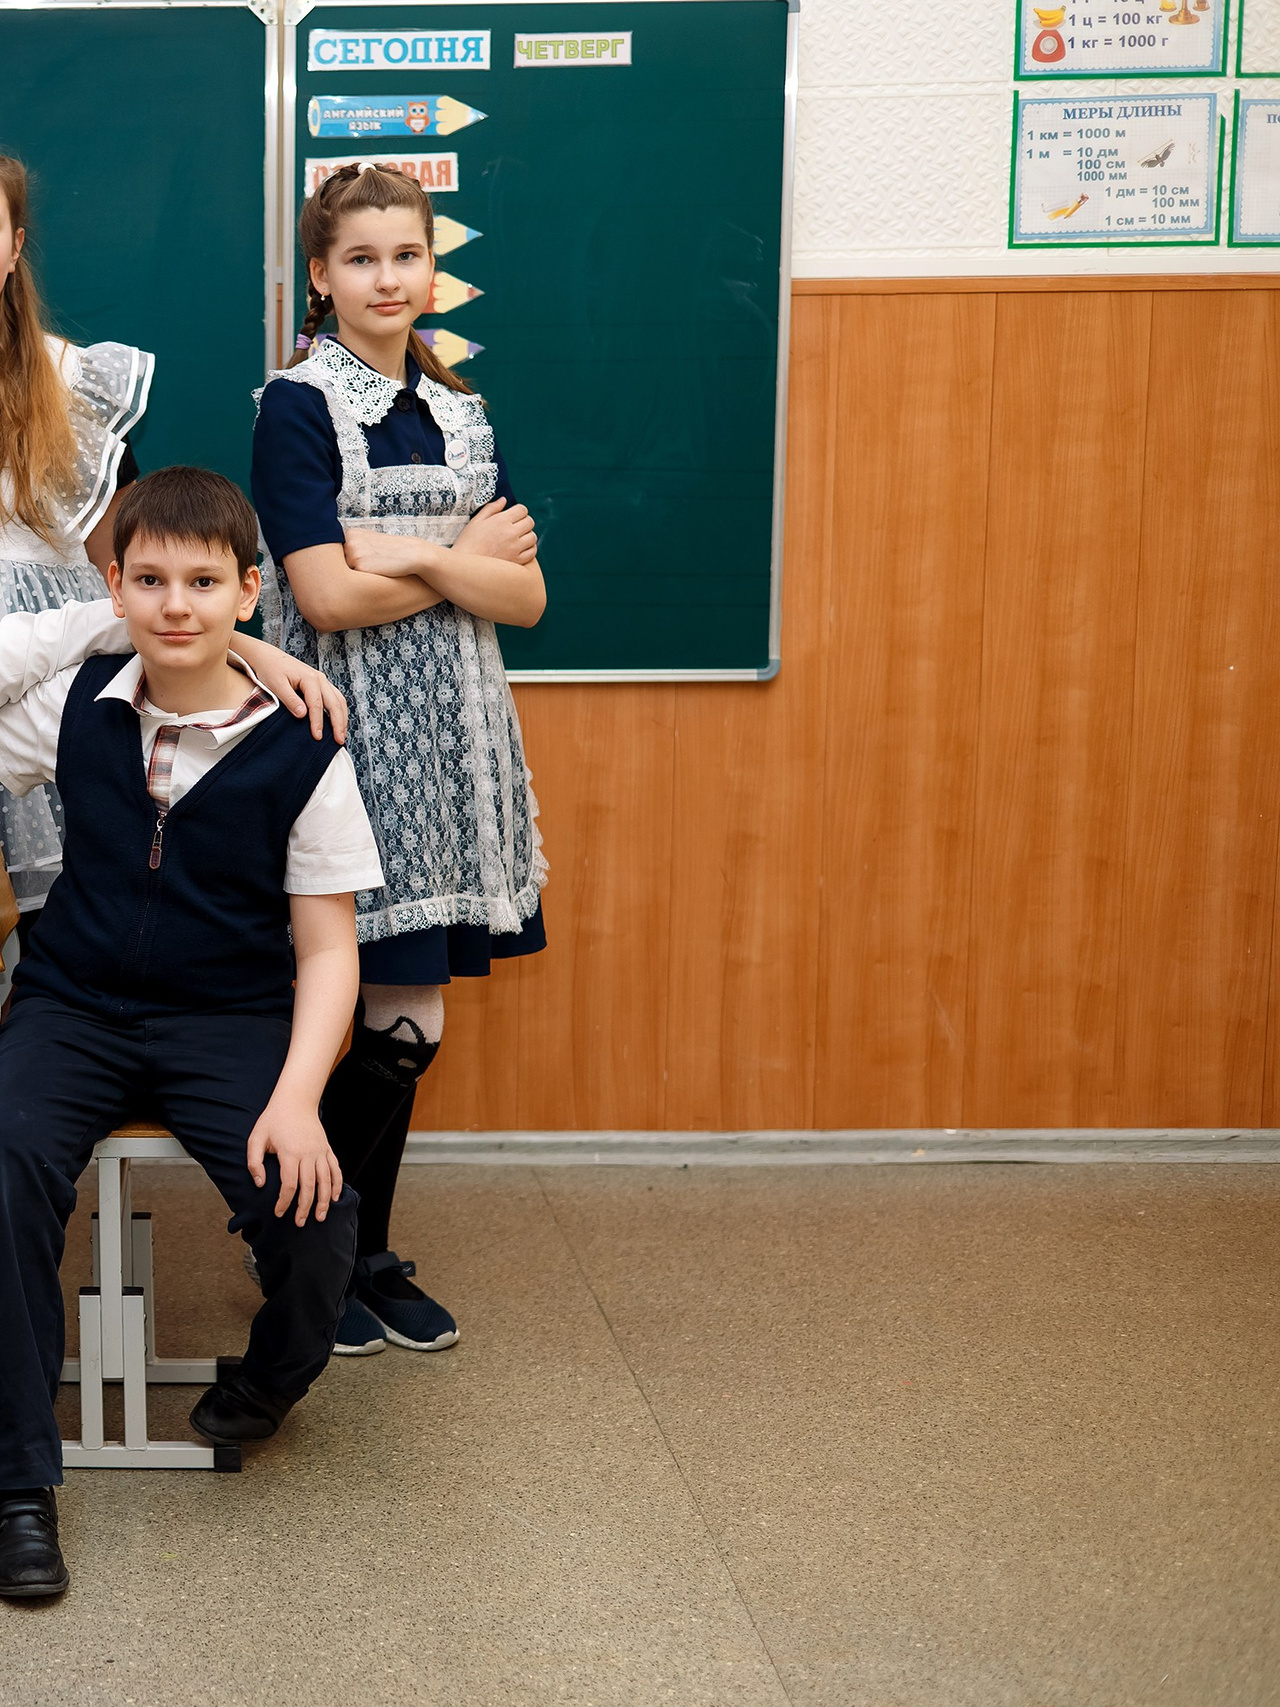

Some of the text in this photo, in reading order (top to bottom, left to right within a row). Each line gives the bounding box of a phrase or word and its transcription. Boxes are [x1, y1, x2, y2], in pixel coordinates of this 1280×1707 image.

[1068, 13, 1076, 27] 1
[1082, 17, 1093, 28] ц
[1112, 12, 1141, 26] 100
[1146, 15, 1162, 25] кг
[1067, 36, 1075, 49] 1
[1082, 39, 1098, 49] кг
[1118, 34, 1156, 48] 1000
[1161, 37, 1169, 47] г
[313, 36, 484, 65] СЕГОДНЯ
[516, 38, 625, 60] ЧЕТВЕРГ
[323, 105, 404, 119] АНГЛИЙСКИЙ
[1062, 104, 1182, 120] МЕРЫ ДЛИНЫ
[348, 121, 382, 131] ЯЗЫК
[1027, 130, 1034, 141] 1
[1039, 131, 1059, 140] км
[1077, 128, 1110, 139] 1000
[1115, 129, 1126, 137] м
[1026, 149, 1033, 159] 1
[1038, 151, 1050, 159] м
[1076, 147, 1093, 158] 10
[1097, 149, 1119, 159] дм
[1076, 159, 1126, 170] 100 см
[1076, 170, 1128, 181] 1000 мм
[1105, 187, 1111, 197] 1
[1115, 188, 1136, 198] дм
[1152, 185, 1168, 195] 10
[1171, 186, 1189, 195] см
[1152, 197, 1200, 208] 100 мм
[1105, 216, 1111, 225] 1
[1116, 216, 1135, 225] см
[1151, 214, 1166, 224] 10
[1170, 215, 1191, 224] мм
